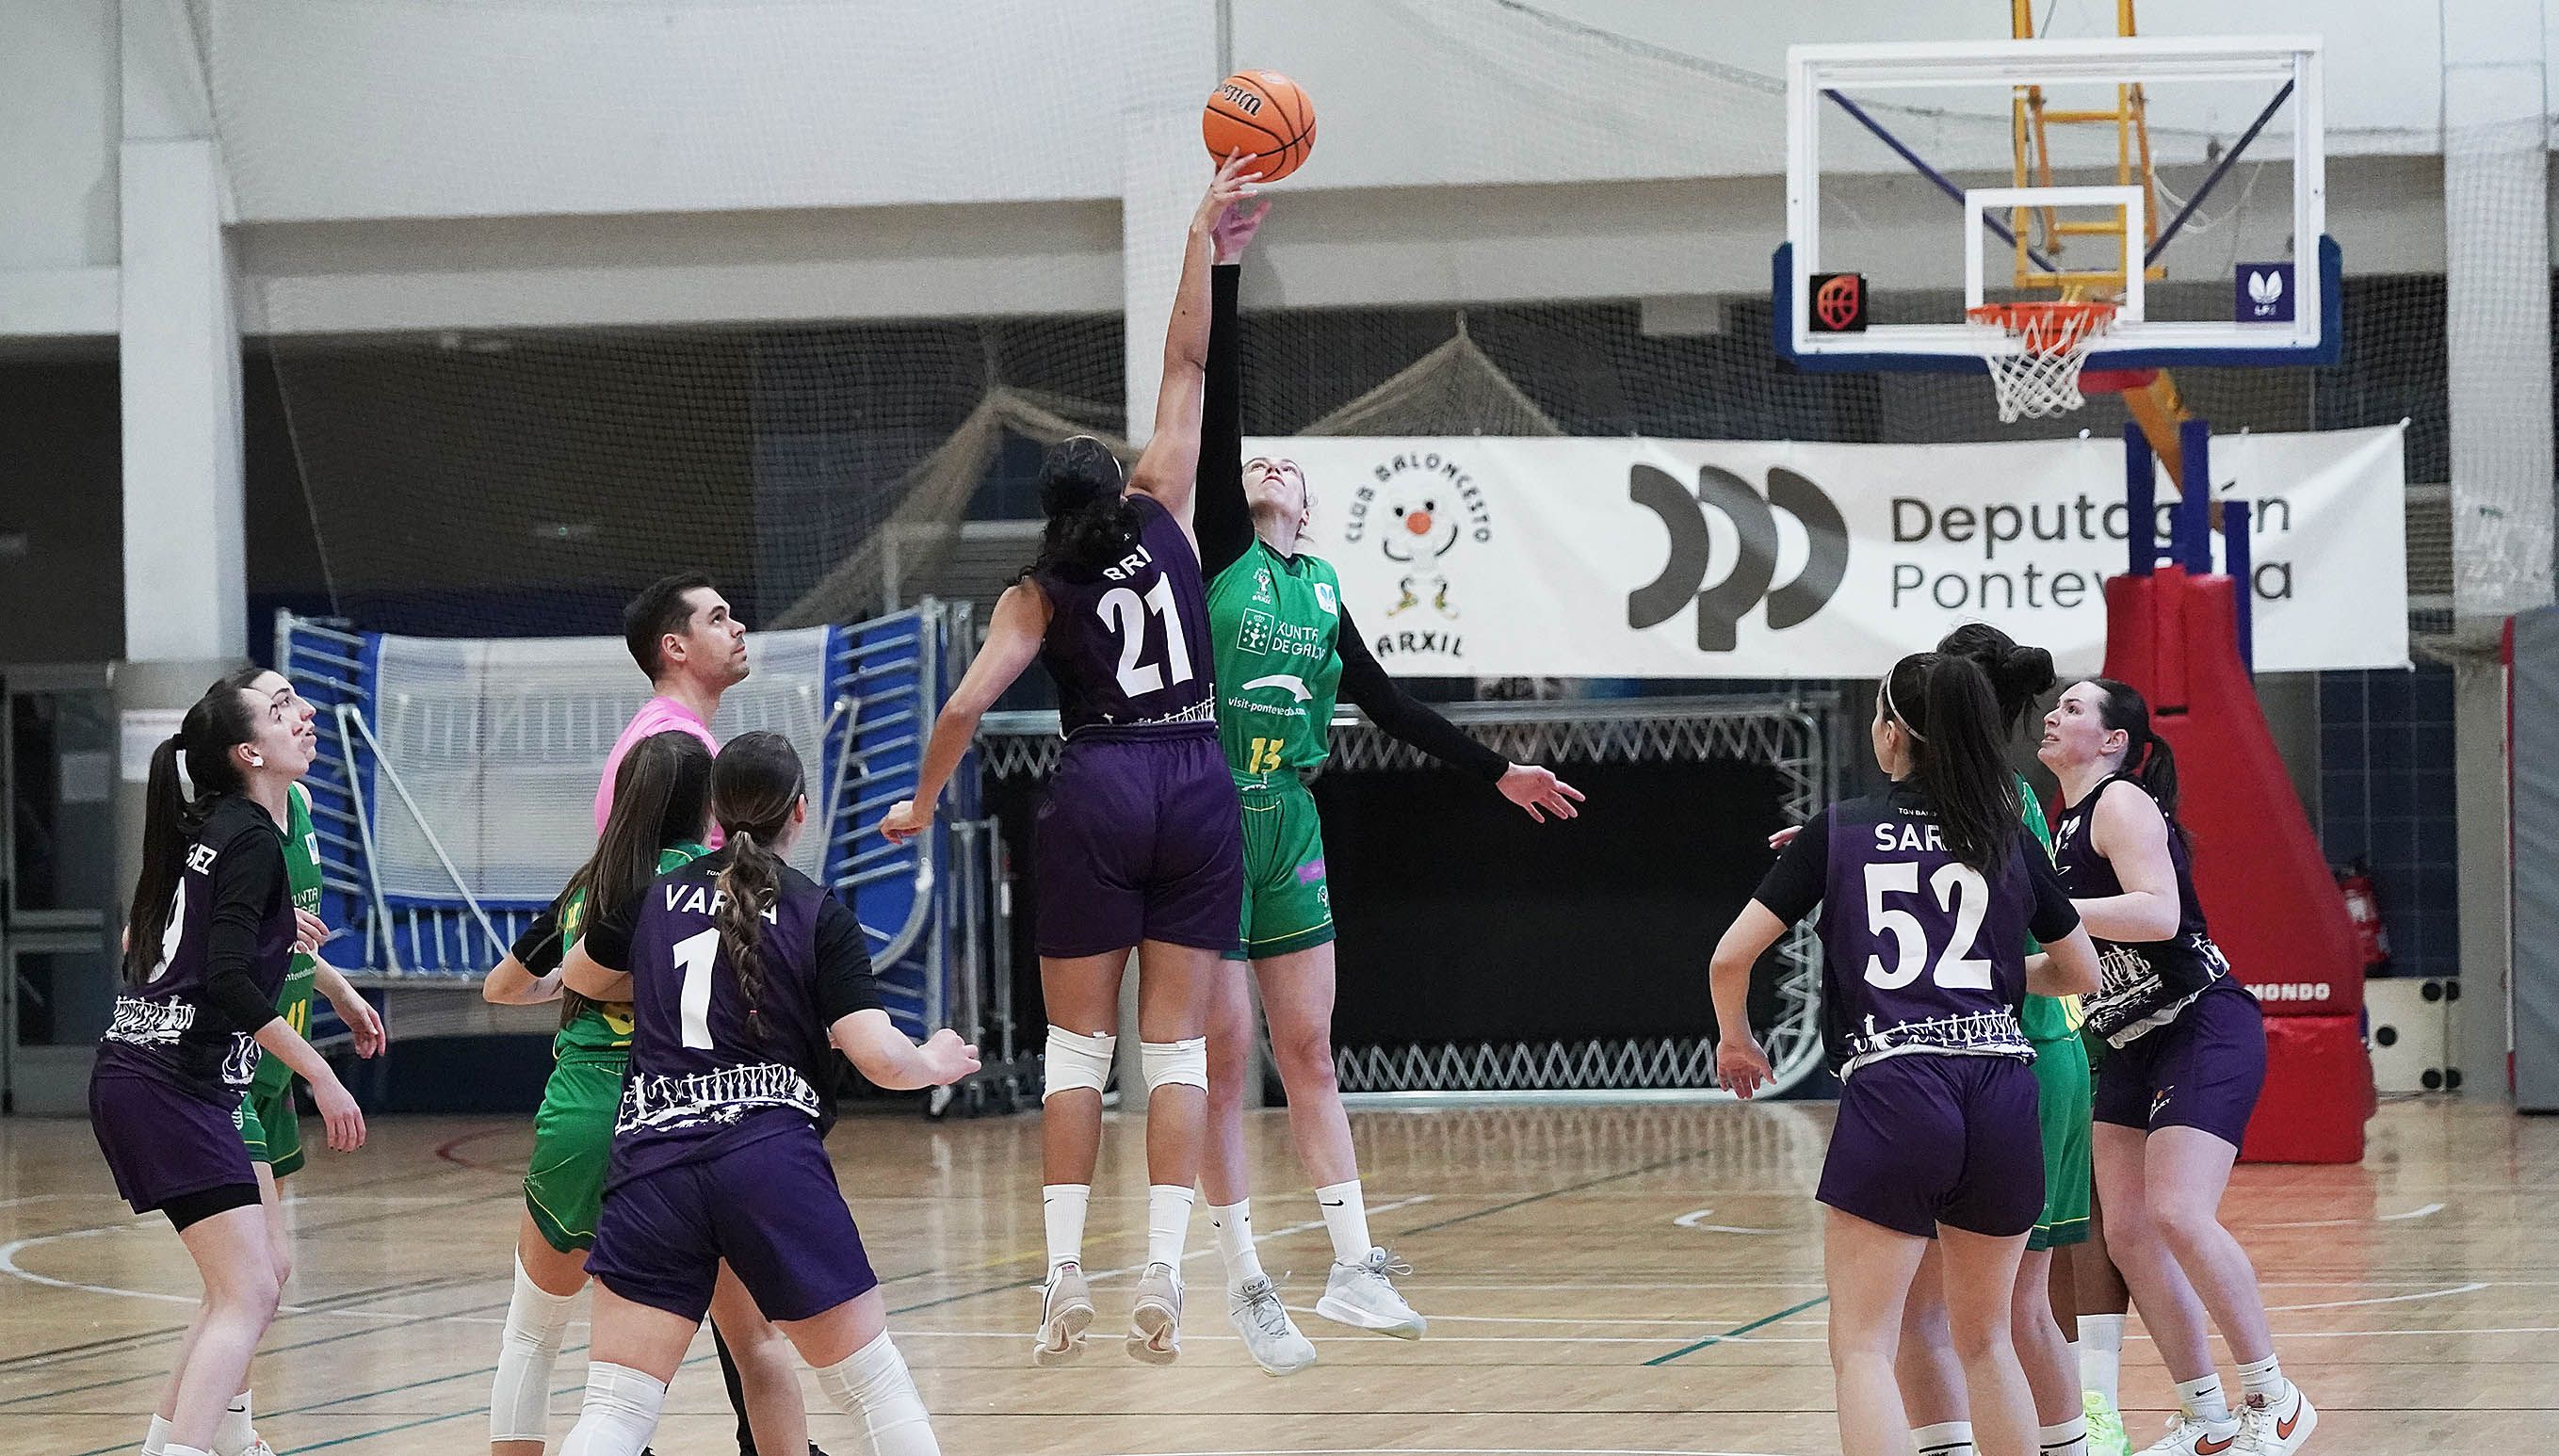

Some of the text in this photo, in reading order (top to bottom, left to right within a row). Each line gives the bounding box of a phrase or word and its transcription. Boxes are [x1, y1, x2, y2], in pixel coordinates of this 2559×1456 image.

[1345, 485, 1376, 543] CLUB
[1891, 563, 2292, 609] Pontea
[1096, 571, 1193, 698] 21
[1377, 631, 1464, 657] ARXIL
[1874, 822, 1953, 852] SAR
[1863, 861, 1994, 990] 52
[672, 927, 721, 1050] 1
[2243, 982, 2331, 1002] MONDO
